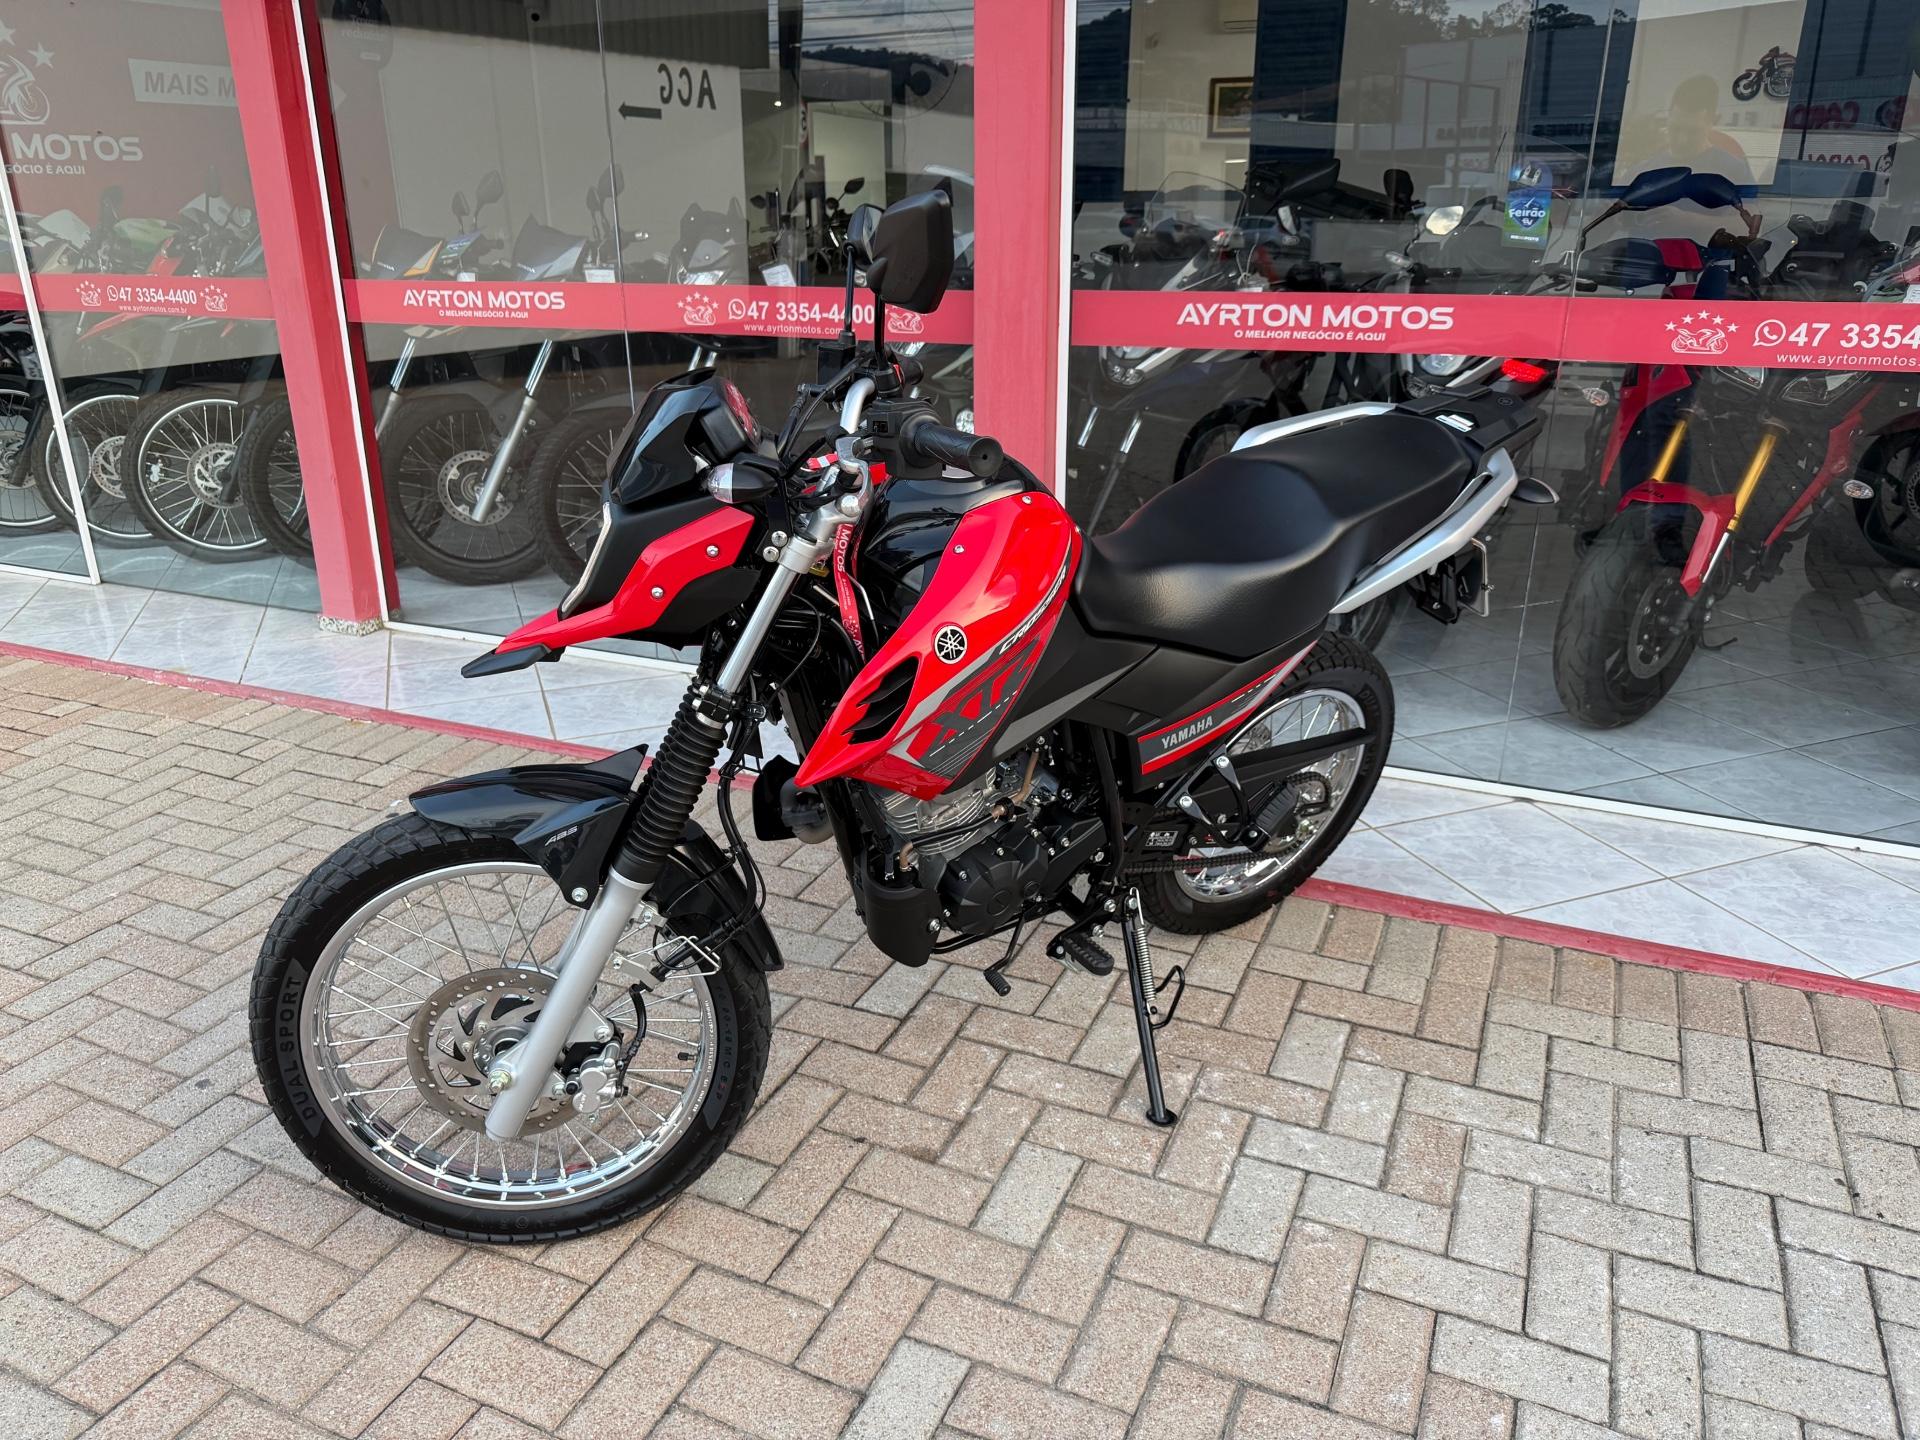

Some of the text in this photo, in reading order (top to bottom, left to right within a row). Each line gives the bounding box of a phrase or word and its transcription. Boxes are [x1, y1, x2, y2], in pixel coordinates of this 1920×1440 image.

[144, 70, 209, 97] MAIS
[11, 131, 144, 162] MOTOS
[55, 164, 86, 175] AQUI
[1508, 207, 1546, 219] Feirão
[119, 287, 197, 305] 47 3354-4400
[403, 288, 566, 310] AYRTON MOTOS
[445, 310, 473, 318] MELHOR
[474, 309, 504, 319] NEGÓCIO
[511, 311, 529, 319] AQUI
[748, 301, 767, 320] 47
[1177, 303, 1455, 330] AYRTON MOTOS
[1234, 328, 1386, 342] O MELHOR NEGÓCIO É AQUI
[1788, 322, 1831, 347] 47
[837, 528, 852, 573] MOTOS
[1161, 715, 1213, 749] YAMAHA
[545, 825, 578, 847] ABS
[279, 976, 317, 1120] DUAL SPORT
